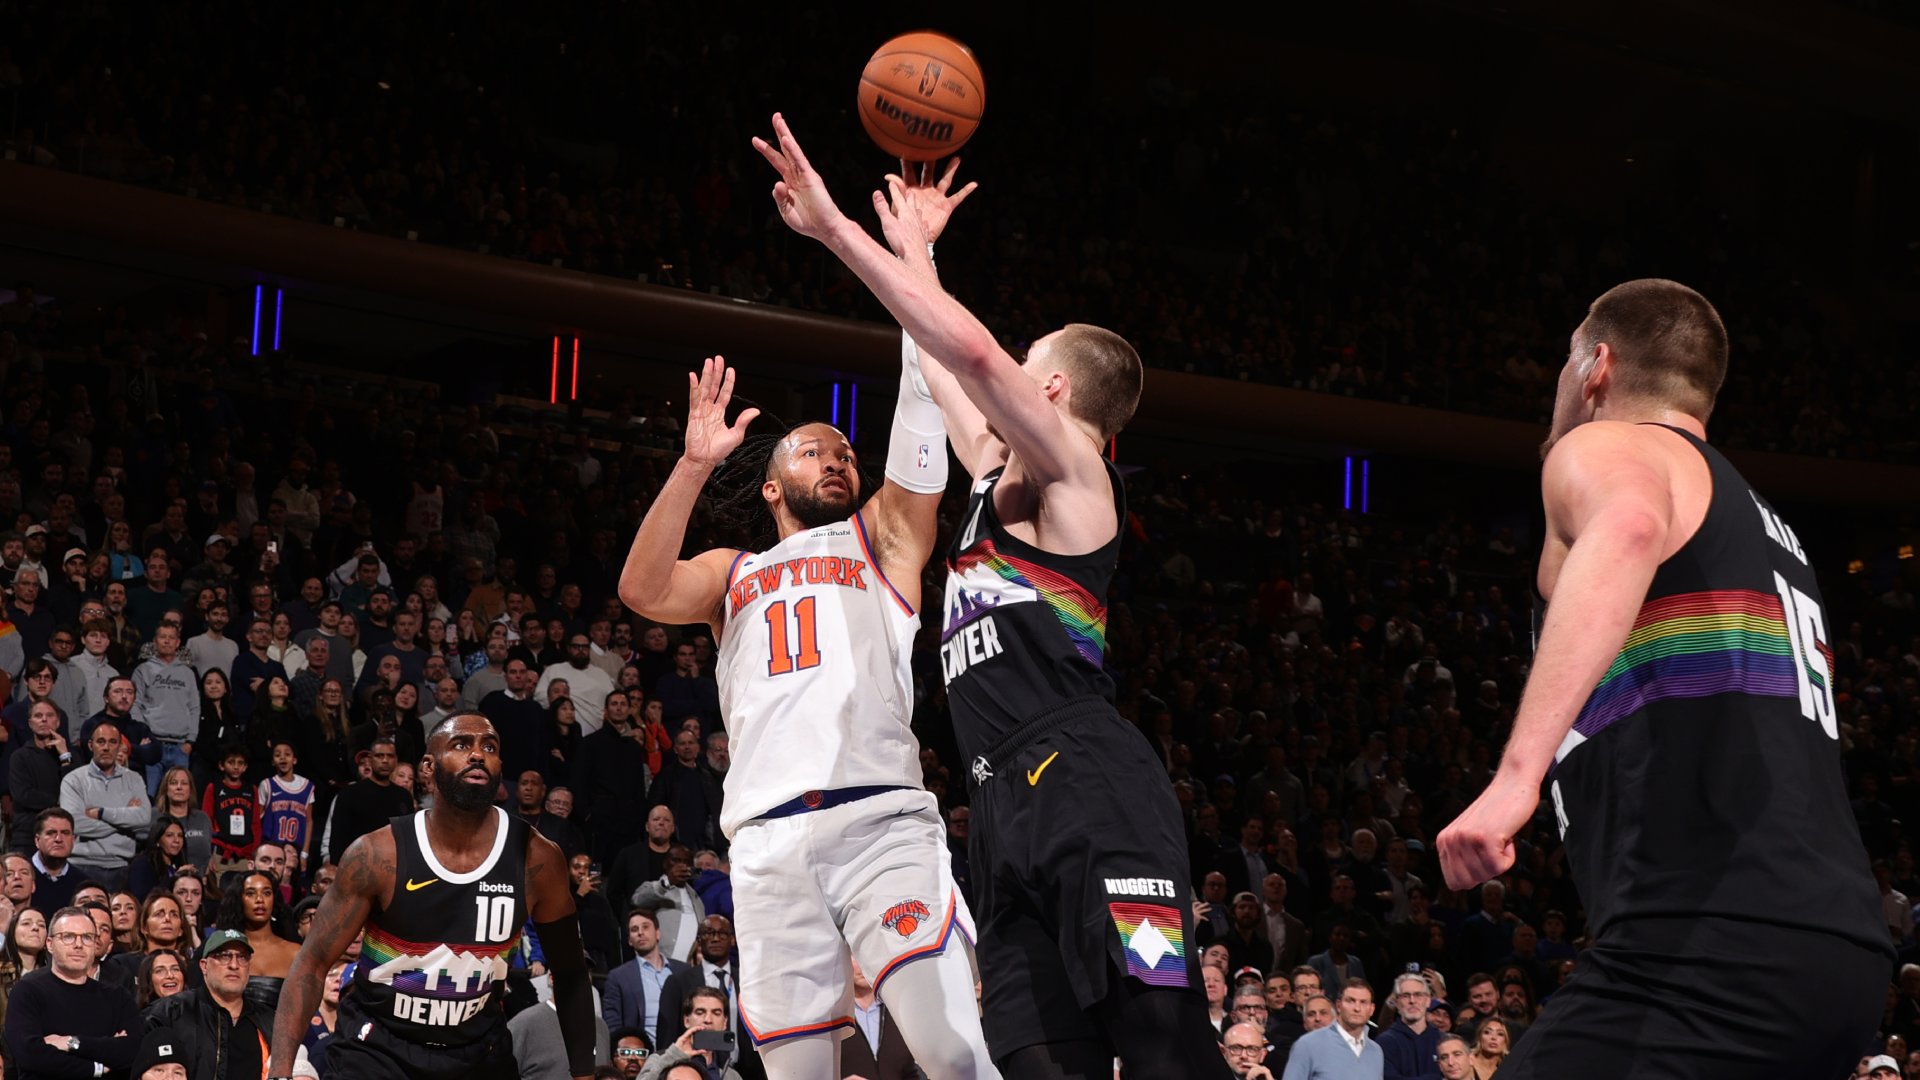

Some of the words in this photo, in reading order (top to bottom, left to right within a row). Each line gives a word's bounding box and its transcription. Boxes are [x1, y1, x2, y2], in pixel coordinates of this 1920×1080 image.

[875, 94, 954, 142] Wilson
[729, 562, 785, 619] NEW
[787, 556, 867, 592] YORK
[764, 595, 821, 677] 11
[1773, 570, 1839, 740] 15
[278, 815, 299, 842] 10
[479, 881, 514, 893] ibotta
[1104, 878, 1176, 898] NUGGETS
[475, 895, 515, 942] 10
[881, 899, 931, 929] KNICKS
[393, 992, 492, 1026] DENVER
